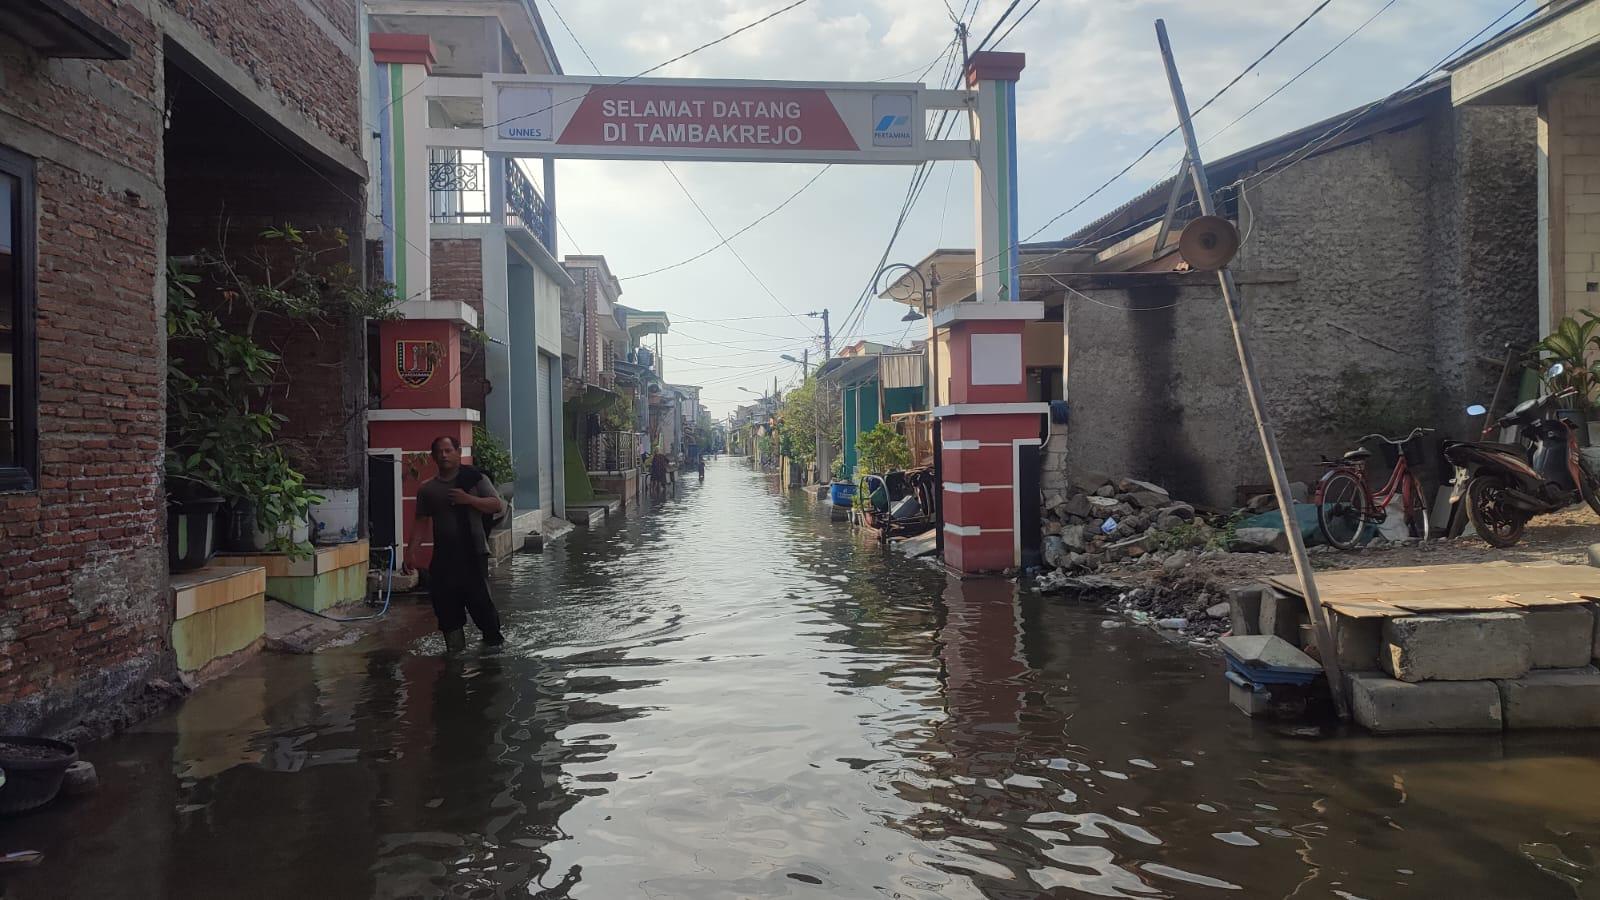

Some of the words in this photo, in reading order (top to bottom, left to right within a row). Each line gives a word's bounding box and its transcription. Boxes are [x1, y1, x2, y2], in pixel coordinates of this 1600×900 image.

[602, 99, 705, 117] SELAMAT
[713, 101, 800, 119] DATANG
[509, 127, 542, 137] UNNES
[603, 122, 626, 142] DI
[634, 123, 802, 145] TAMBAKREJO
